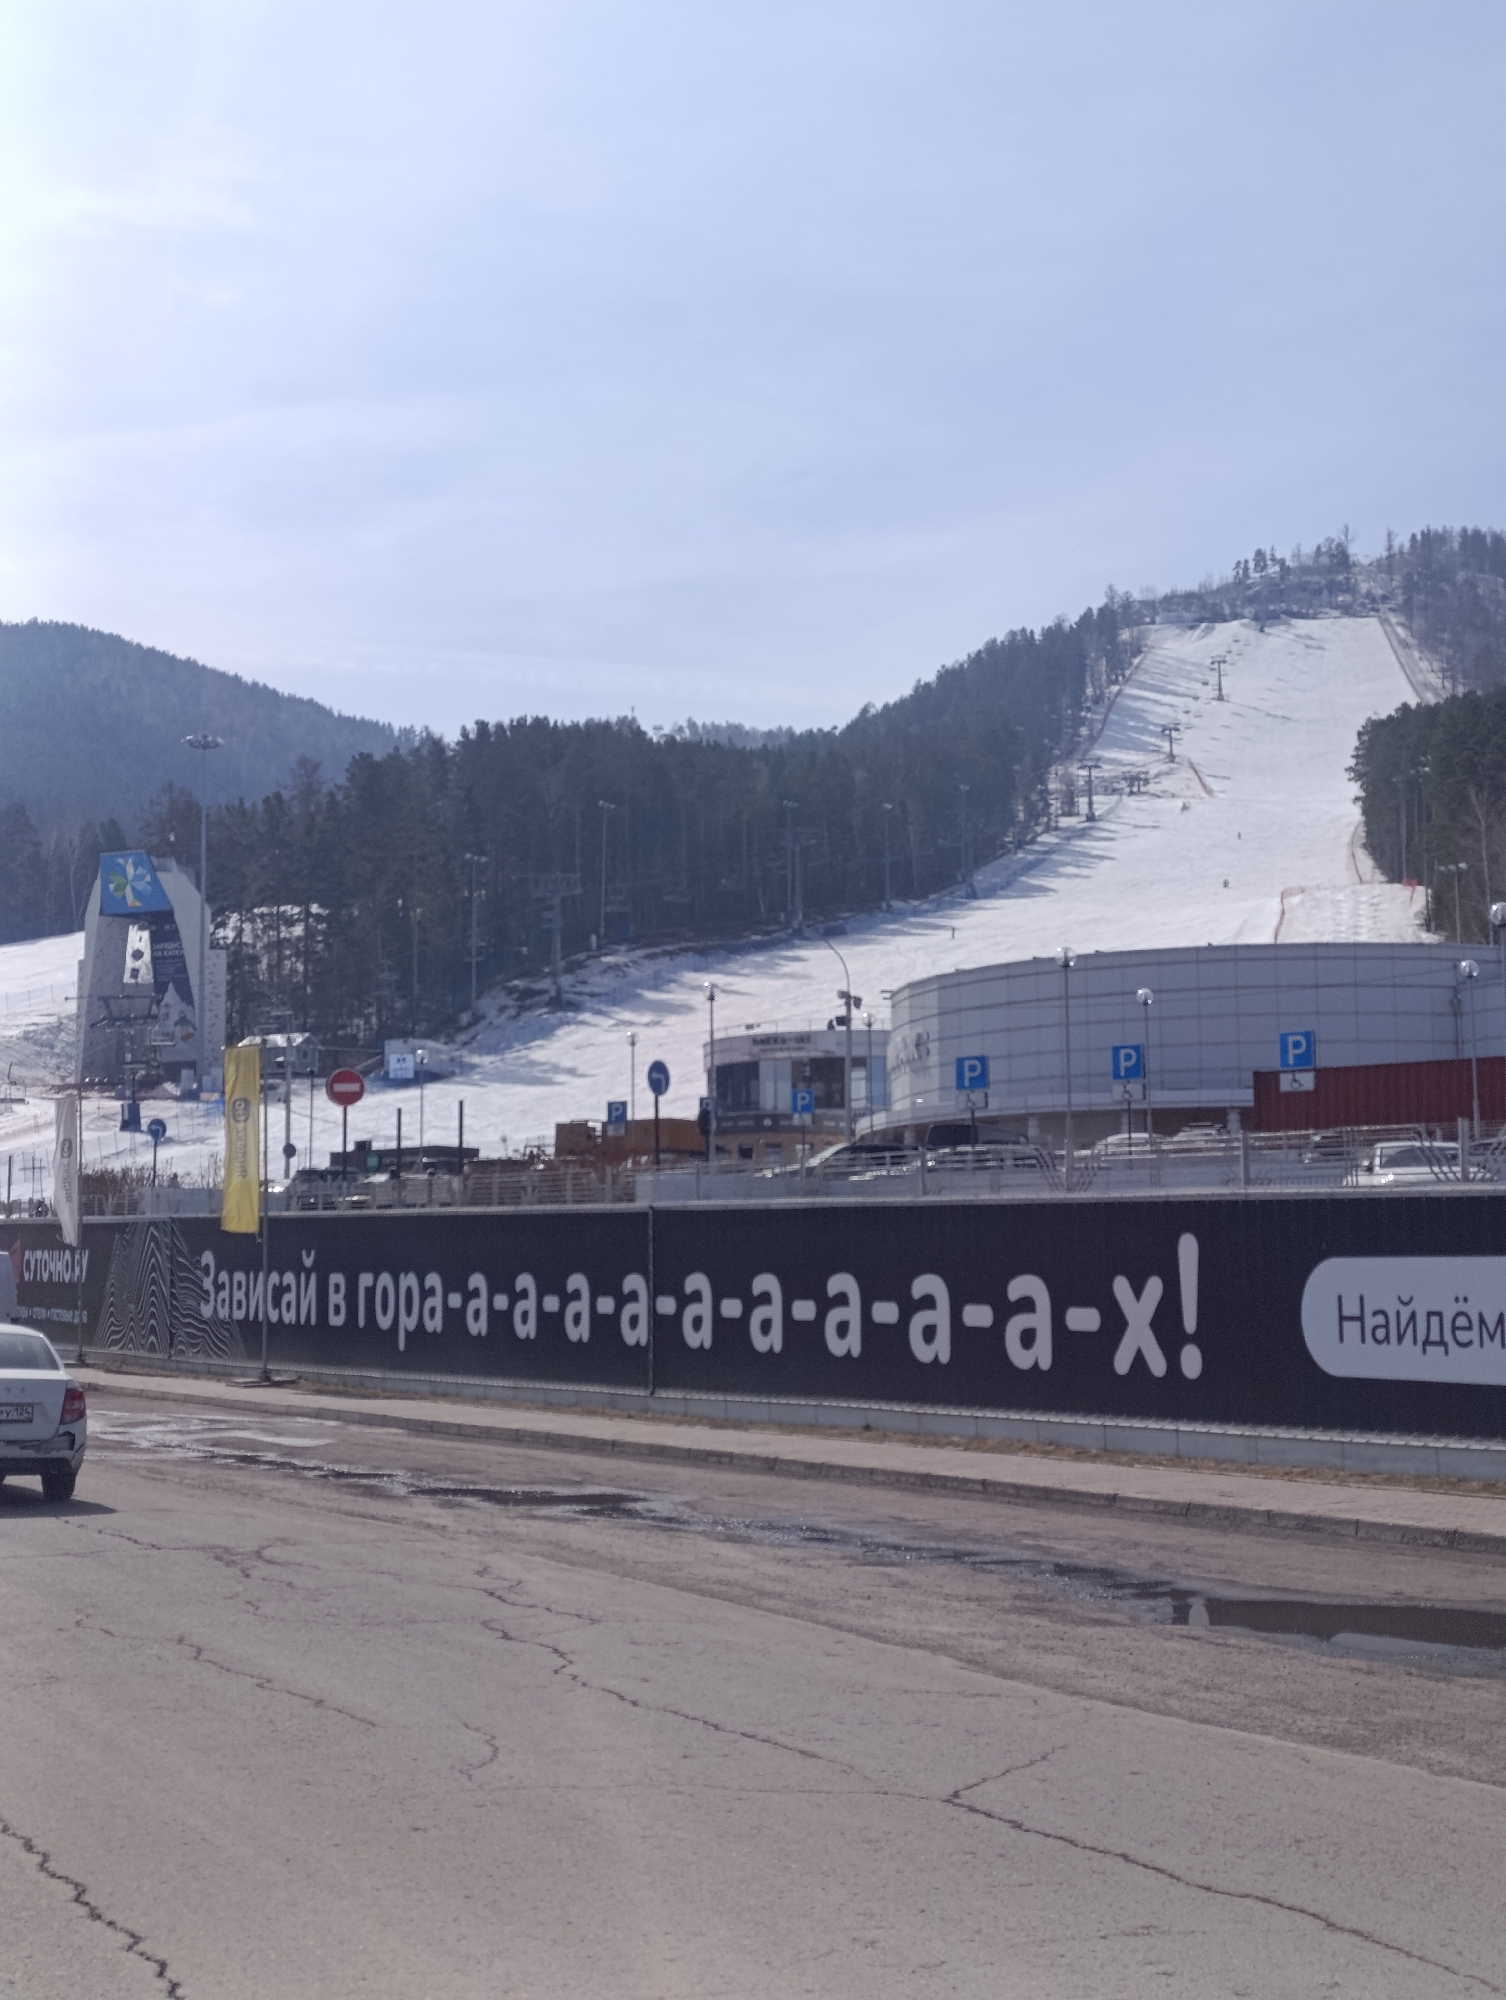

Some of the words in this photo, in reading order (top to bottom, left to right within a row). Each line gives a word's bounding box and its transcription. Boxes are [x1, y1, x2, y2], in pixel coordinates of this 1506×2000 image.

[1119, 1049, 1137, 1077] P
[1287, 1035, 1307, 1066] P
[963, 1059, 982, 1088] P
[611, 1103, 623, 1122] P
[796, 1091, 810, 1111] P
[199, 1249, 318, 1327] Зависай
[328, 1272, 346, 1327] в
[1336, 1294, 1506, 1357] Найдём
